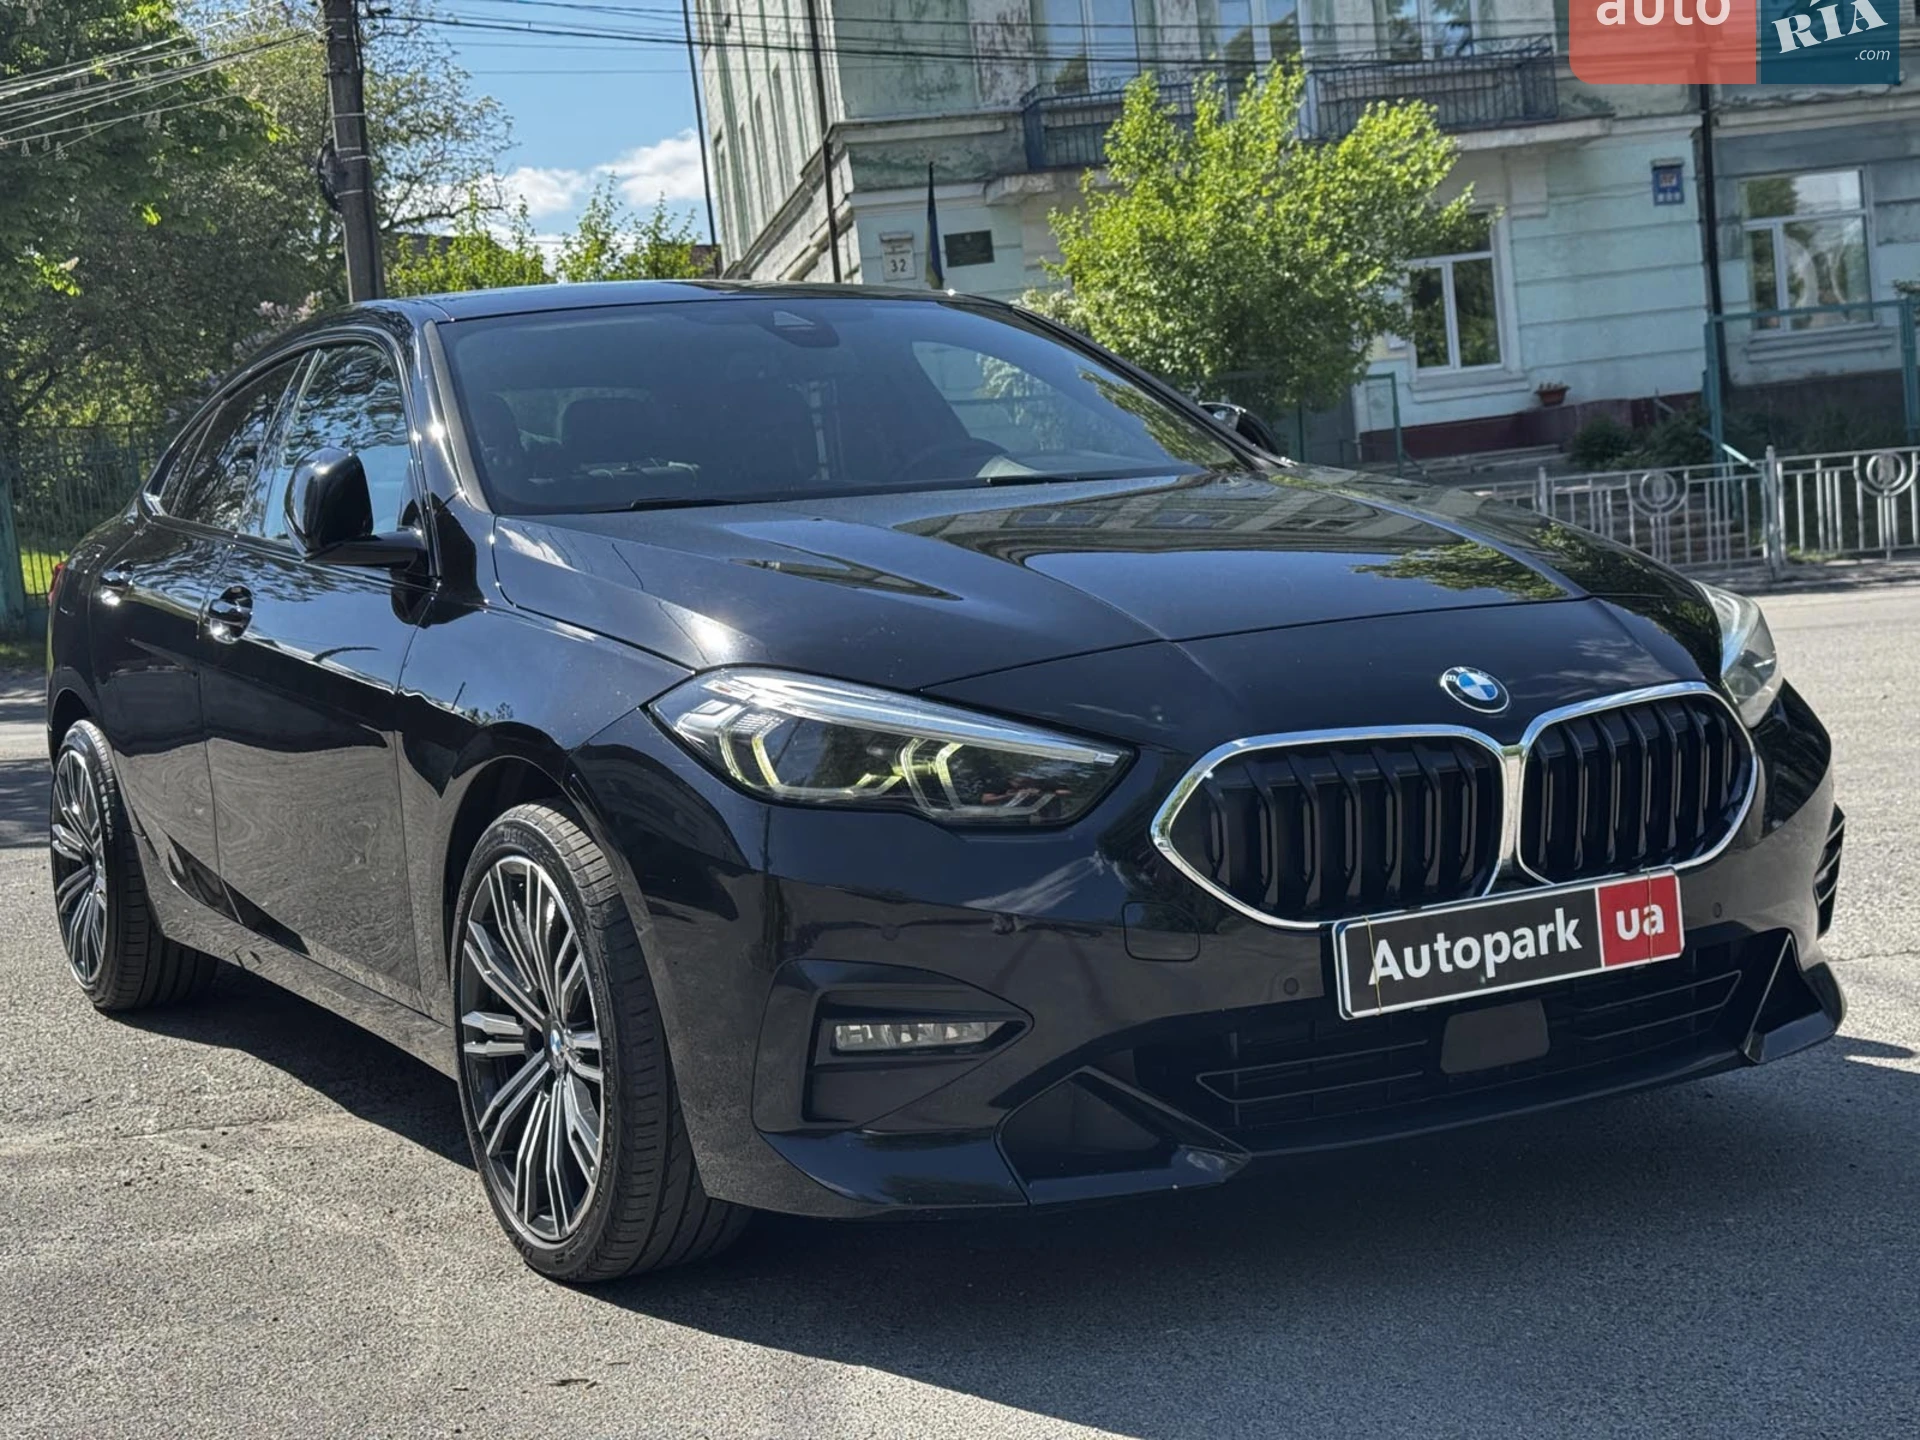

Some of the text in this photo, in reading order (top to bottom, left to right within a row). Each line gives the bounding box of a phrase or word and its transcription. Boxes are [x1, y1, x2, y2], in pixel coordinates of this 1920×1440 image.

[890, 258, 907, 273] 32
[1368, 904, 1665, 986] Autopark ua
